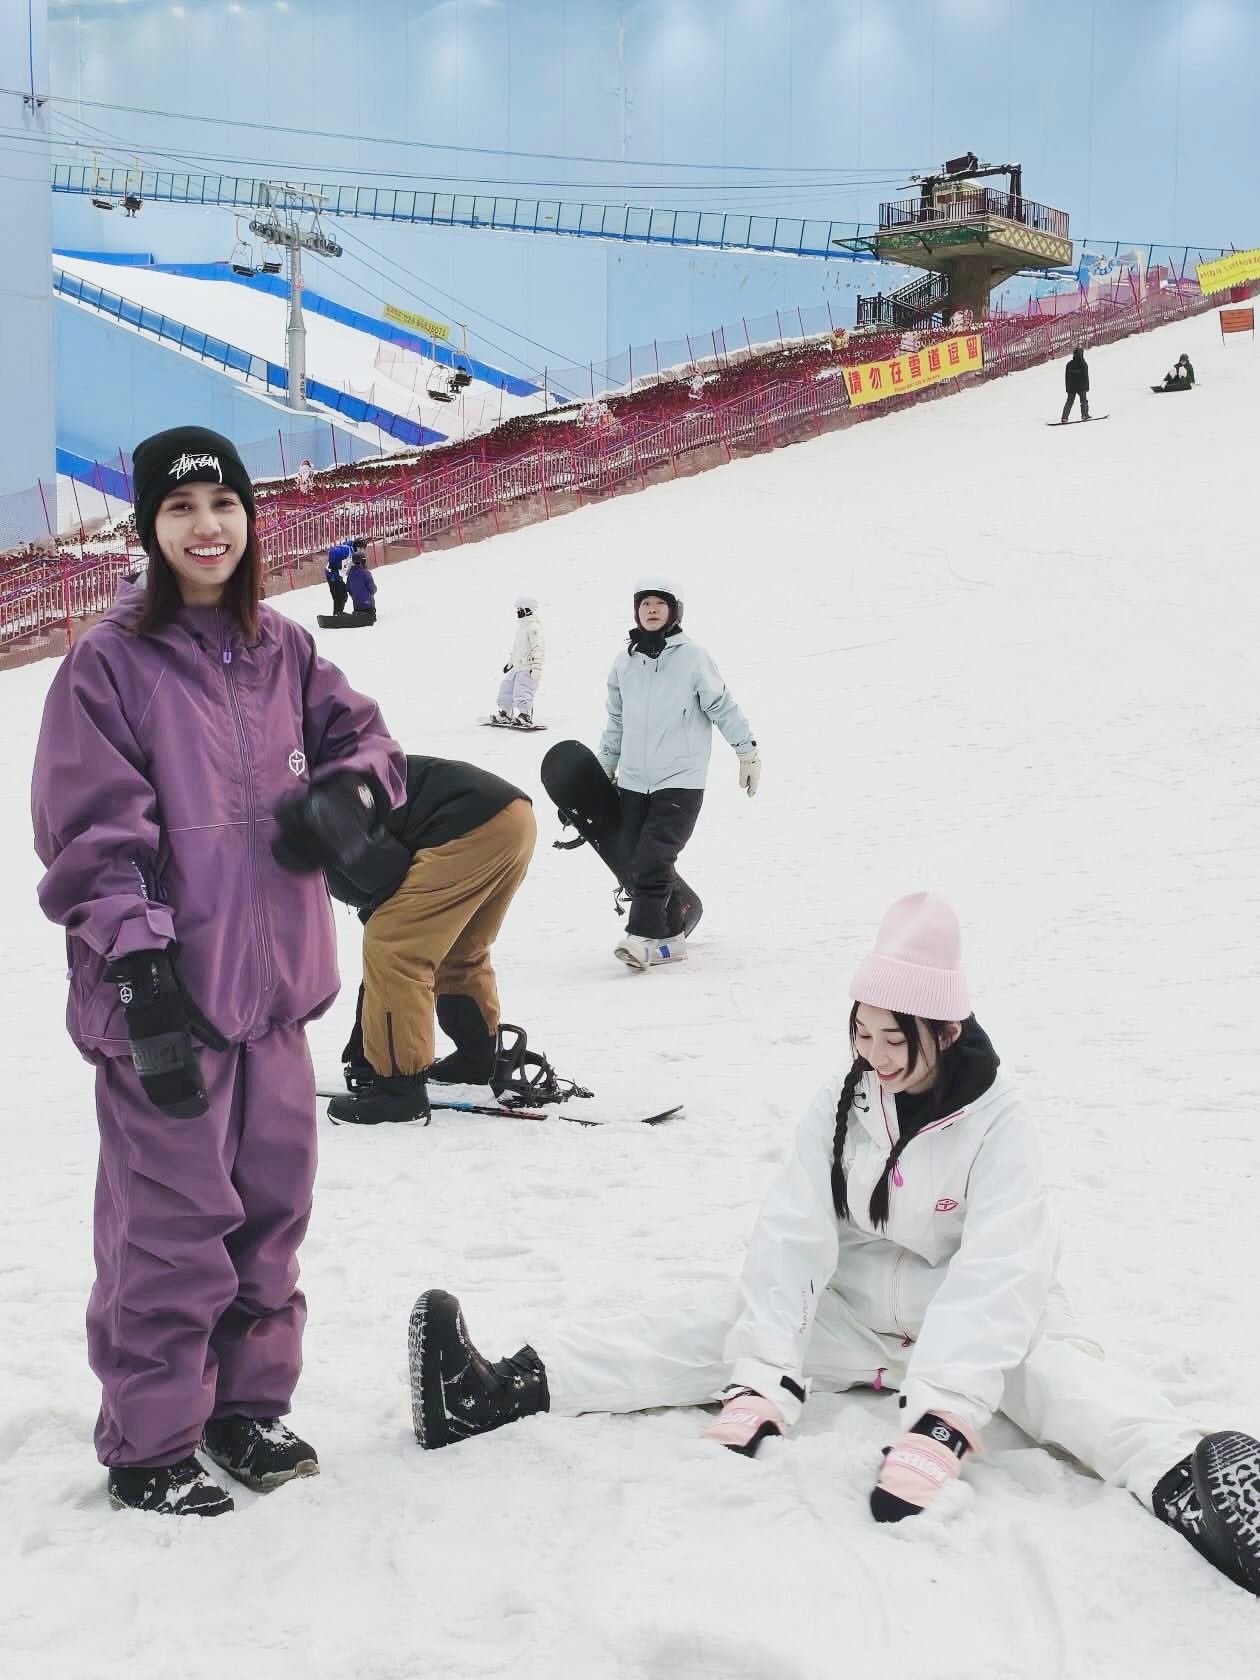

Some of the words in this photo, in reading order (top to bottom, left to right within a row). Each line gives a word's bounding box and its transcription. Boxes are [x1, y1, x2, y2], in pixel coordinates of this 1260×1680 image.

[848, 335, 978, 395] 请勿在雪道逗留
